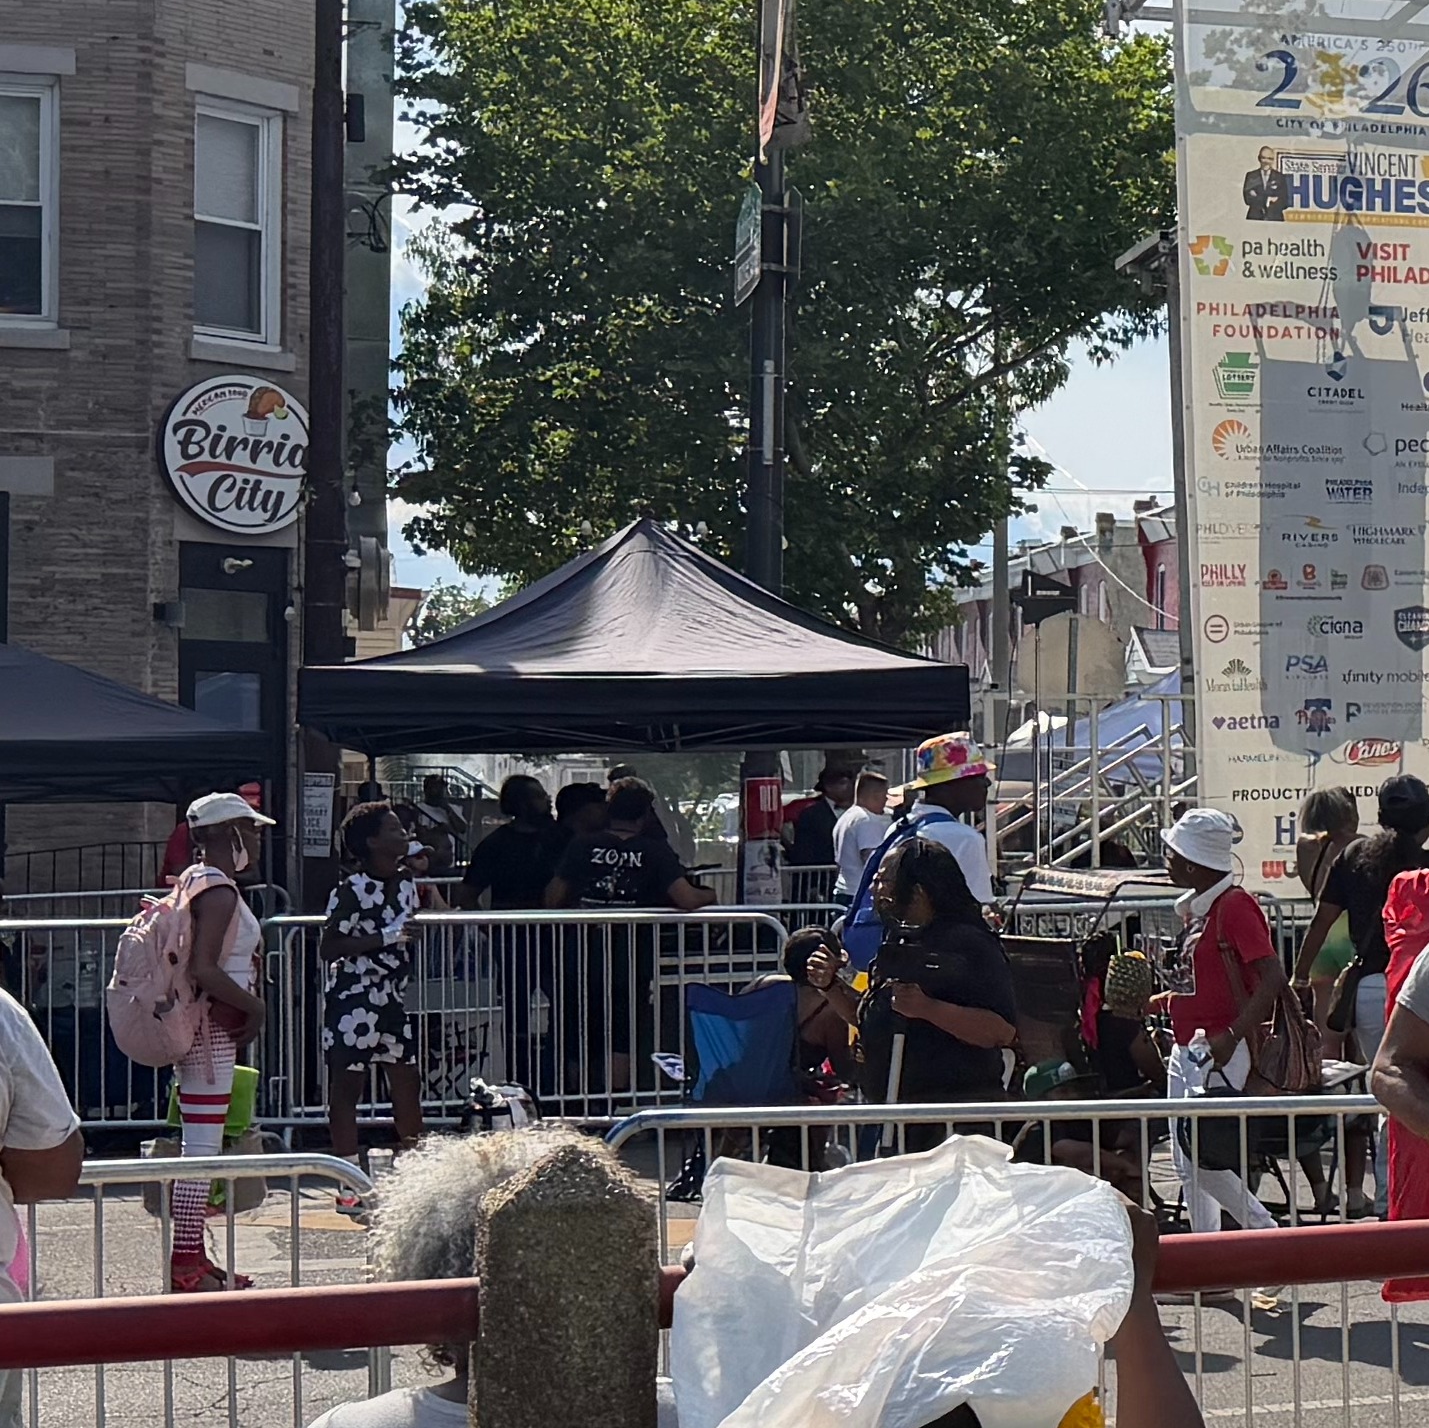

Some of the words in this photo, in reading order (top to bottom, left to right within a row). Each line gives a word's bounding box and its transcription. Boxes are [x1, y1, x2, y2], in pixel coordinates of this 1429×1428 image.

[1276, 119, 1304, 129] CITY
[1347, 152, 1419, 178] VINCENT
[1242, 239, 1263, 259] pa
[1266, 238, 1325, 258] health
[1356, 241, 1411, 262] VISIT
[1242, 262, 1257, 278] &
[1258, 261, 1338, 281] wellness
[1196, 302, 1340, 320] PHILADELPHIA
[1212, 324, 1340, 340] FOUNDATION
[1307, 386, 1365, 400] CITADEL
[1266, 444, 1299, 454] Affairs
[1302, 444, 1343, 455] Coalition
[207, 473, 285, 523] City
[1326, 486, 1373, 501] WATER
[1282, 533, 1339, 542] RIVERS
[1200, 563, 1246, 580] PHILLY
[1286, 655, 1328, 674] PSA
[1227, 714, 1280, 730] aetna
